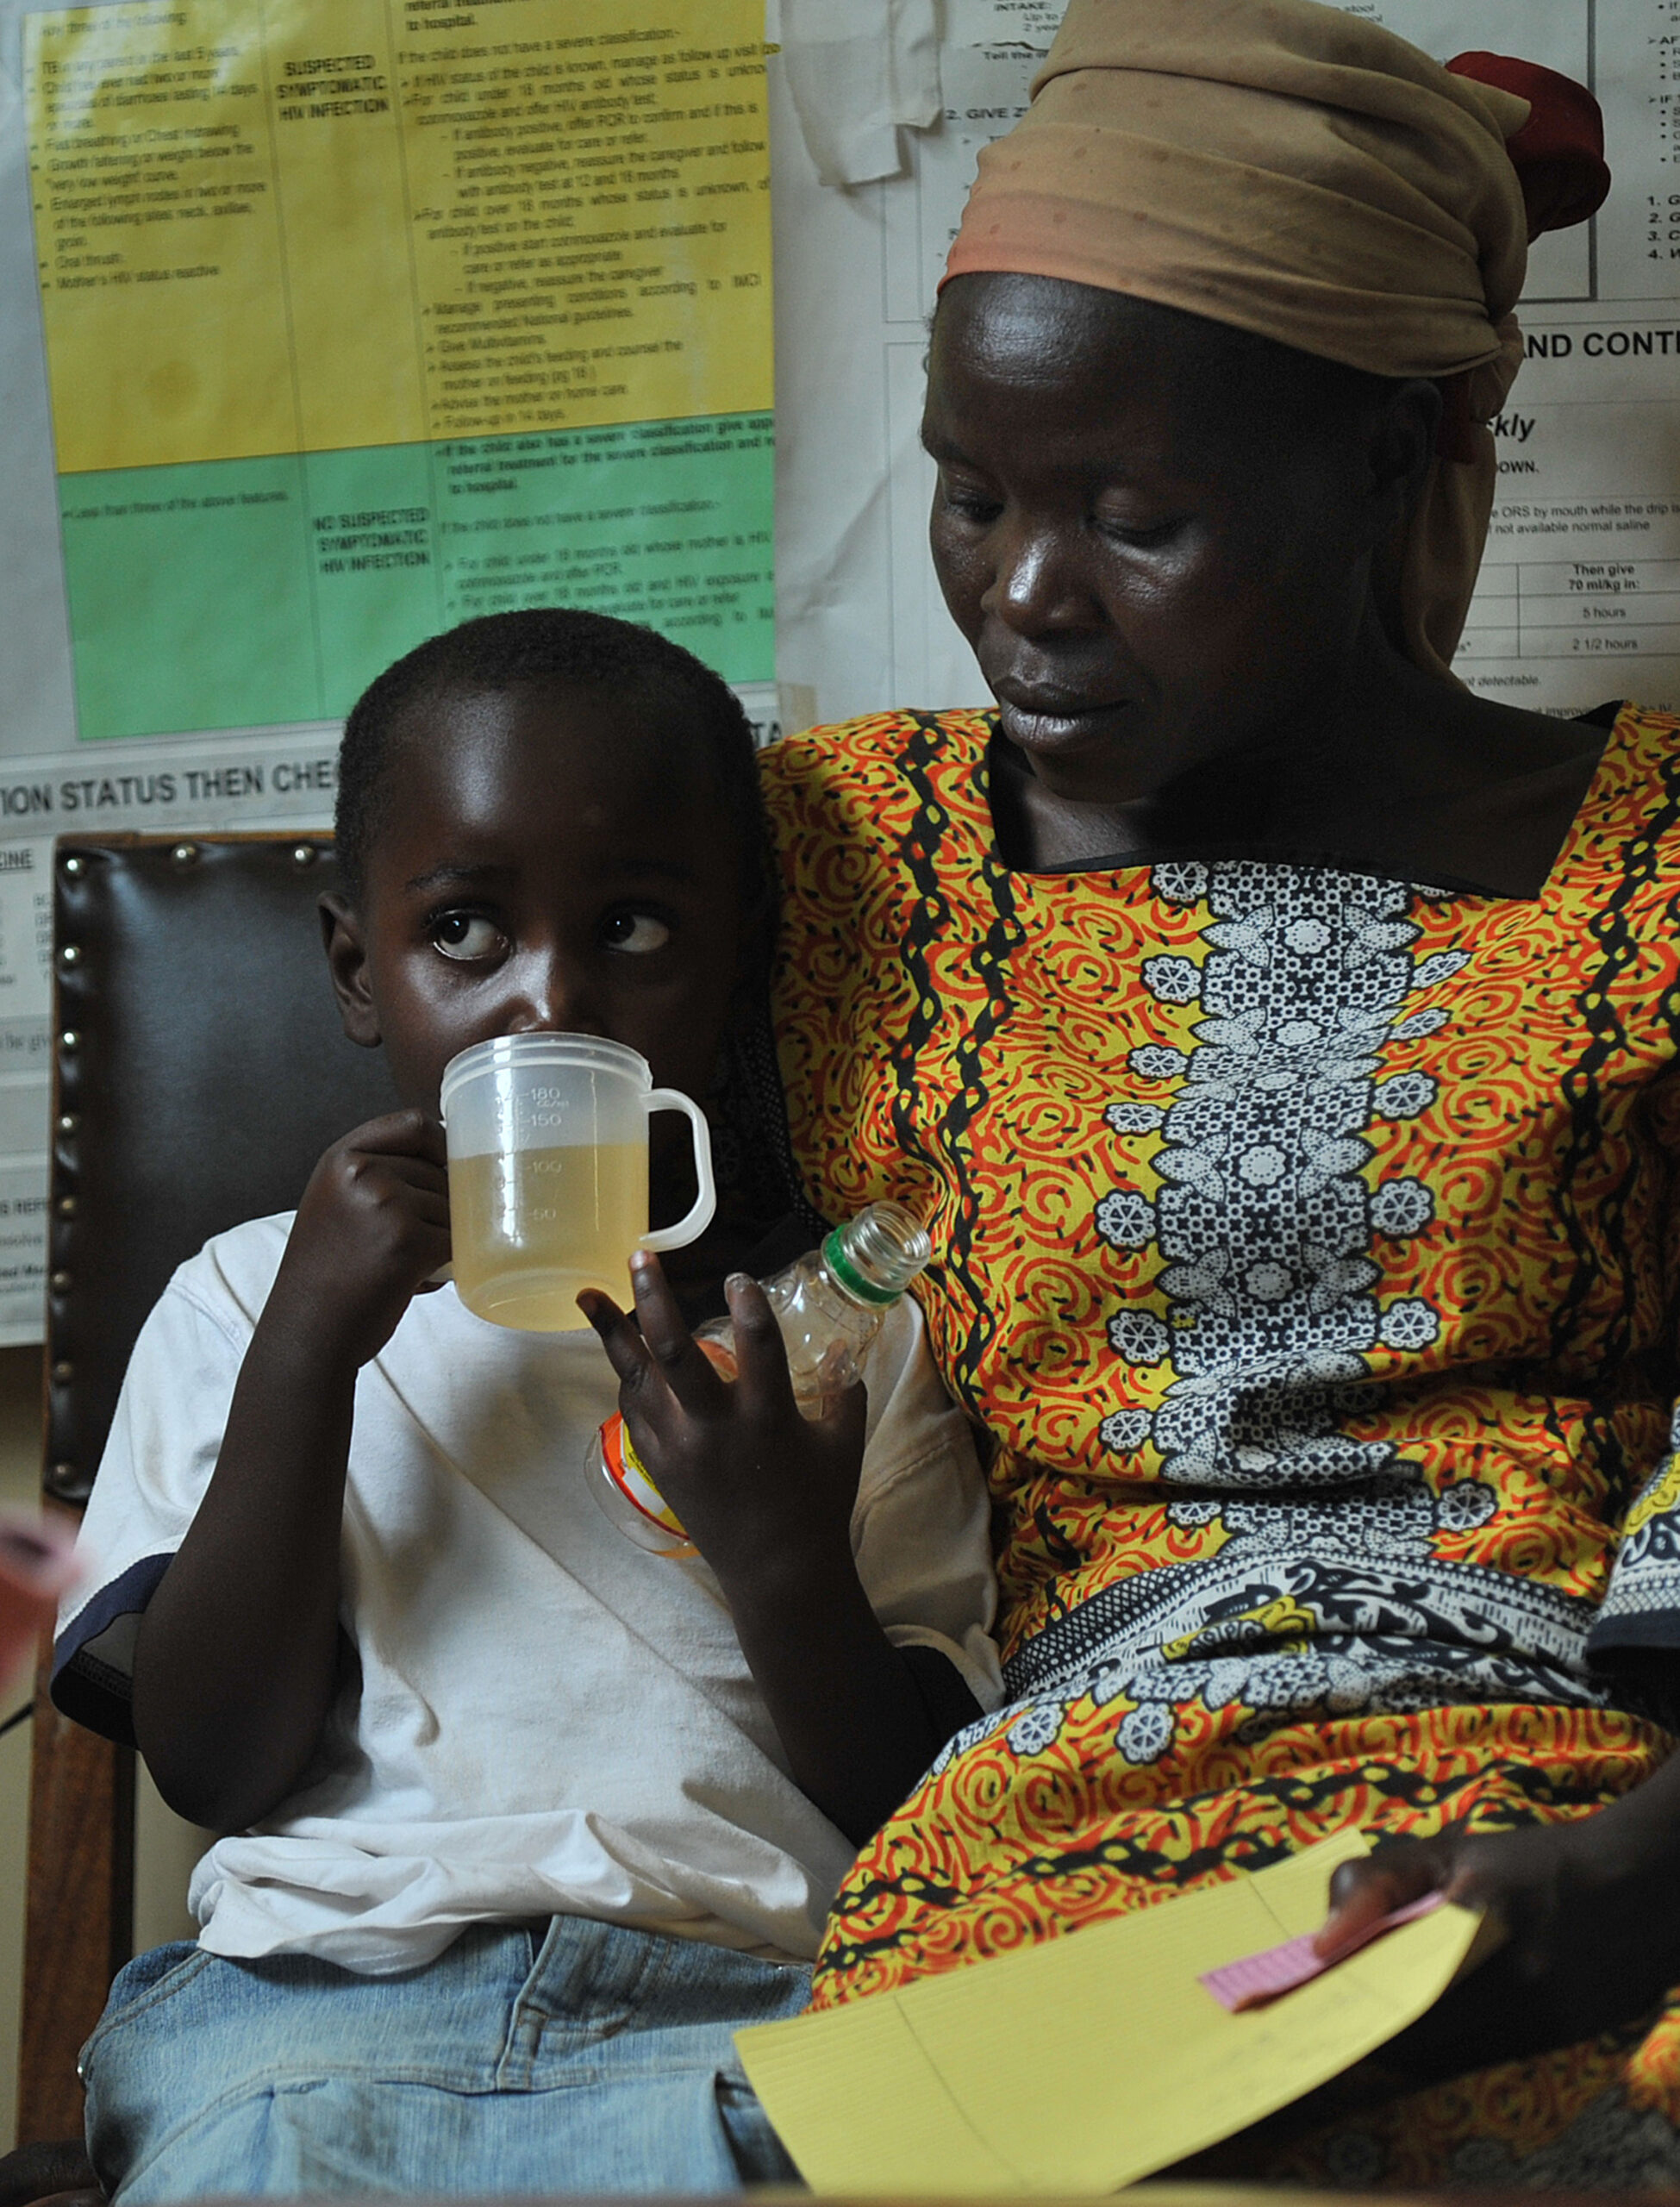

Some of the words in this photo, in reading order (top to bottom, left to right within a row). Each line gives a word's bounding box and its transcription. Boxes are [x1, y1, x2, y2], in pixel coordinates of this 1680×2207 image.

[284, 54, 375, 76] SUSPECTED
[276, 76, 387, 98] SYMPTOMATIC
[278, 104, 303, 121] HIV
[311, 97, 389, 119] INFECTION
[966, 108, 1009, 119] GIVE
[1523, 334, 1573, 359] ND
[1487, 413, 1536, 443] kly
[1502, 506, 1530, 518] ORS
[1534, 507, 1548, 518] by
[1551, 505, 1588, 516] mouth
[1591, 504, 1621, 516] while
[1625, 503, 1643, 515] the
[1646, 502, 1669, 516] drip
[340, 507, 429, 529] SUSPECTED
[1496, 523, 1514, 535] not
[1517, 522, 1569, 535] available
[1572, 521, 1613, 532] normal
[1616, 520, 1650, 531] saline
[318, 528, 426, 552] SYMPTOMATIC
[351, 551, 429, 571] INFECTION
[1573, 565, 1605, 576] Then
[1608, 565, 1635, 579] give
[1568, 579, 1583, 591] 70
[1586, 579, 1621, 593] ml/kg
[1624, 579, 1640, 590] in:
[1583, 607, 1590, 618] 5
[1593, 605, 1627, 618] hours
[1572, 639, 1581, 651] 2
[1584, 637, 1603, 650] 1/2
[1604, 637, 1638, 650] hours
[1478, 675, 1540, 686] detectable.
[60, 773, 177, 812] STATUS
[184, 766, 263, 801] THEN
[530, 1086, 560, 1101] 180
[530, 1114, 562, 1127] 150
[532, 1160, 562, 1173] 100
[532, 1209, 557, 1221] 50
